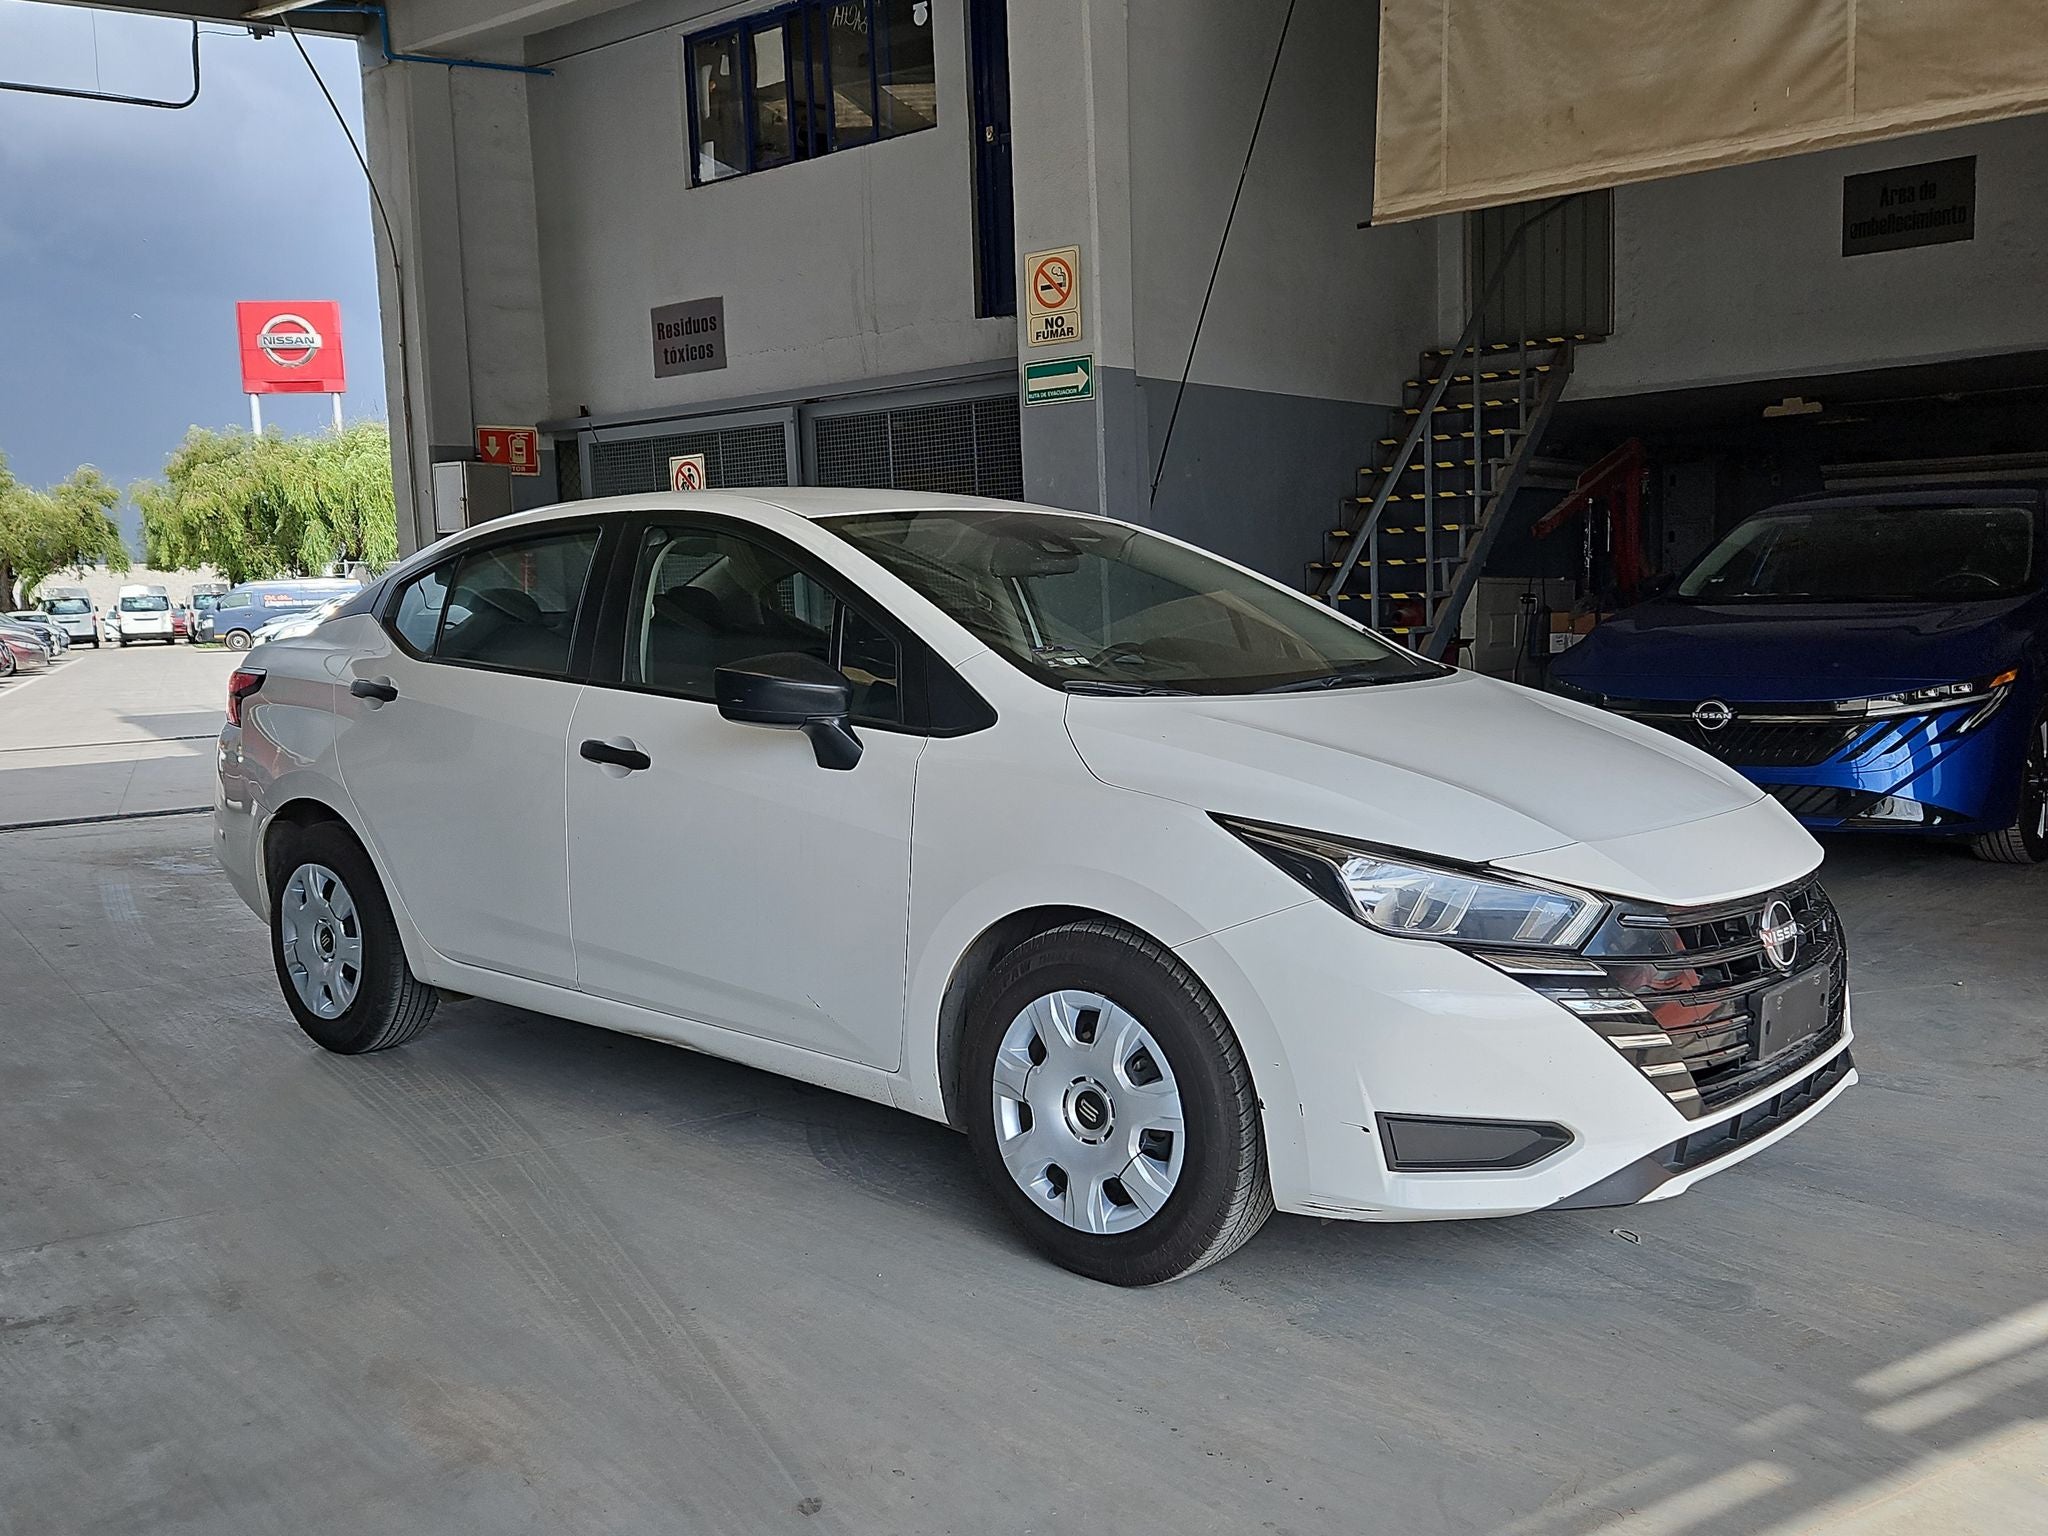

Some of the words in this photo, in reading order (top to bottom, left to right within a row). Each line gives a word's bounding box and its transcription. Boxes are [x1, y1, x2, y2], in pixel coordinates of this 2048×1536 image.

[1919, 180, 1937, 200] de
[657, 316, 717, 341] Residuos
[1045, 316, 1065, 330] NO
[263, 336, 315, 345] NISSAN
[1036, 327, 1074, 340] FUMAR
[664, 343, 714, 365] tóxicos
[1759, 921, 1798, 945] NISSA
